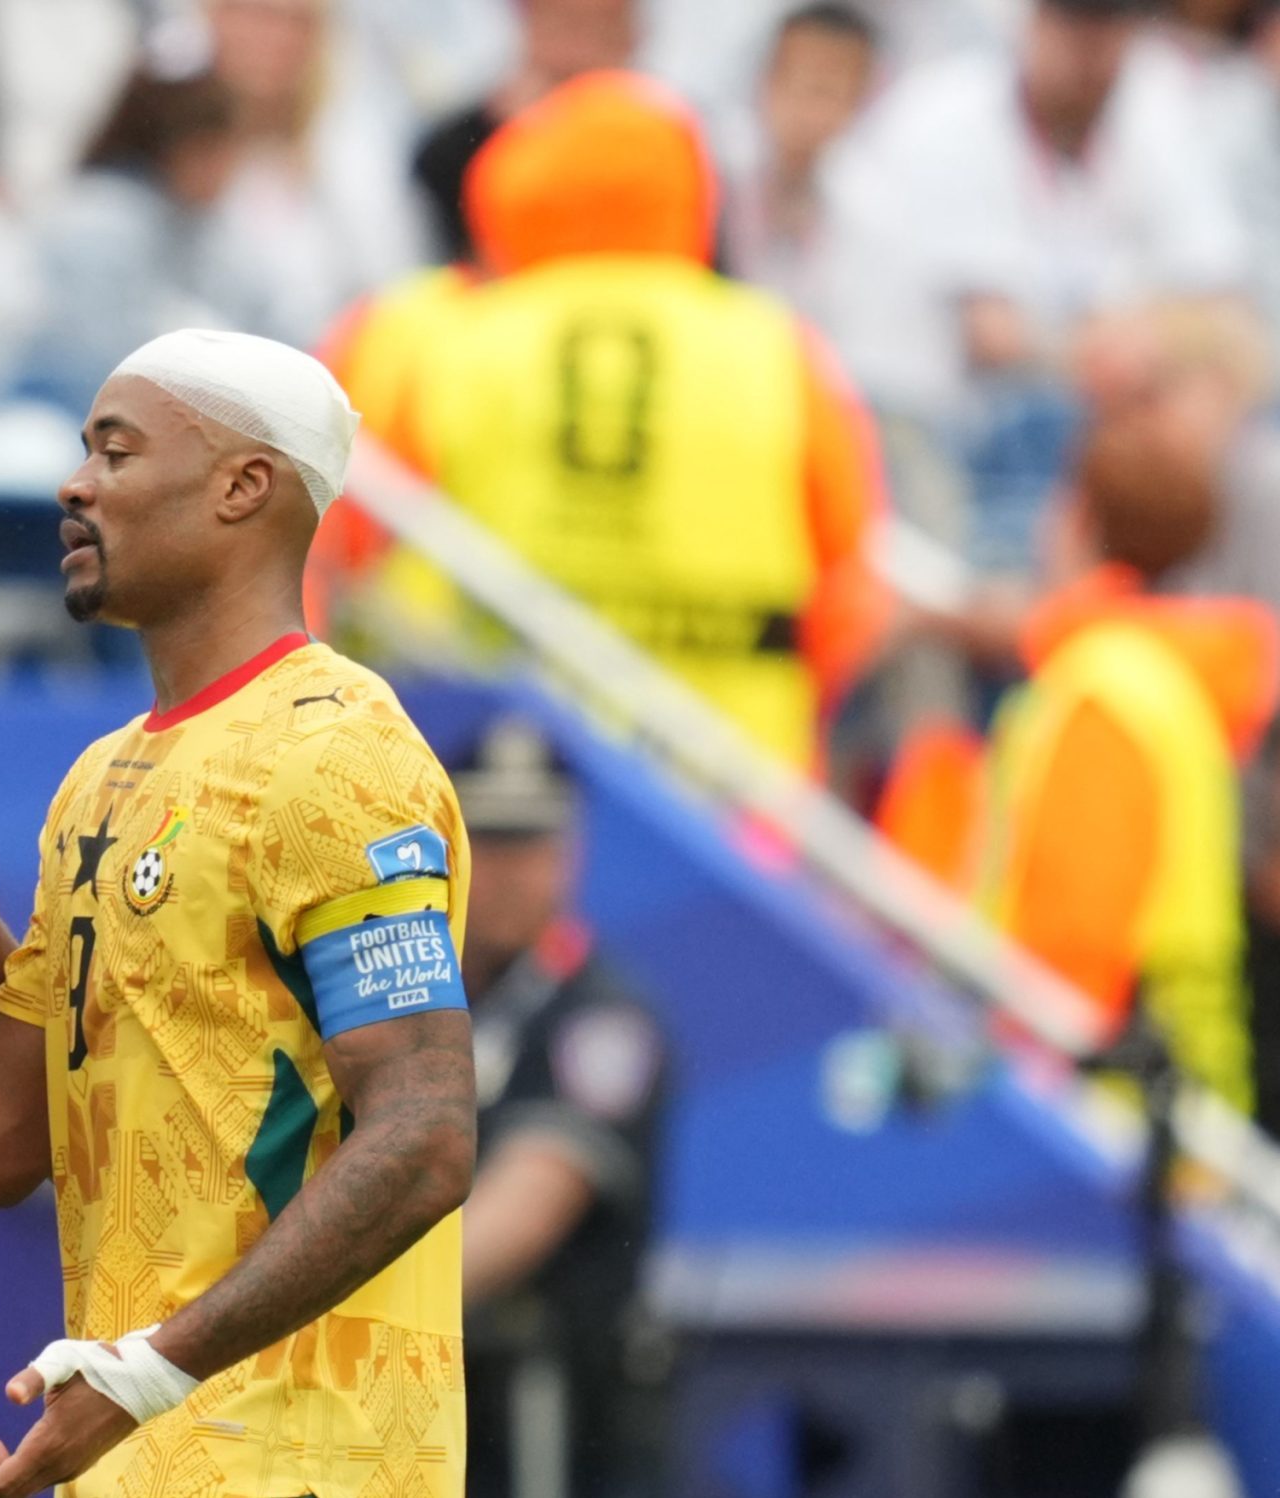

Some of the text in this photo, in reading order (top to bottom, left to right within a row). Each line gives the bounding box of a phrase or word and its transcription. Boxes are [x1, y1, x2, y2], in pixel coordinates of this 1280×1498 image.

[350, 920, 439, 950] FOOTBALL
[354, 937, 446, 974] UNITES
[68, 916, 96, 1071] 9
[354, 961, 451, 997] the World
[391, 990, 426, 1007] FIFA
